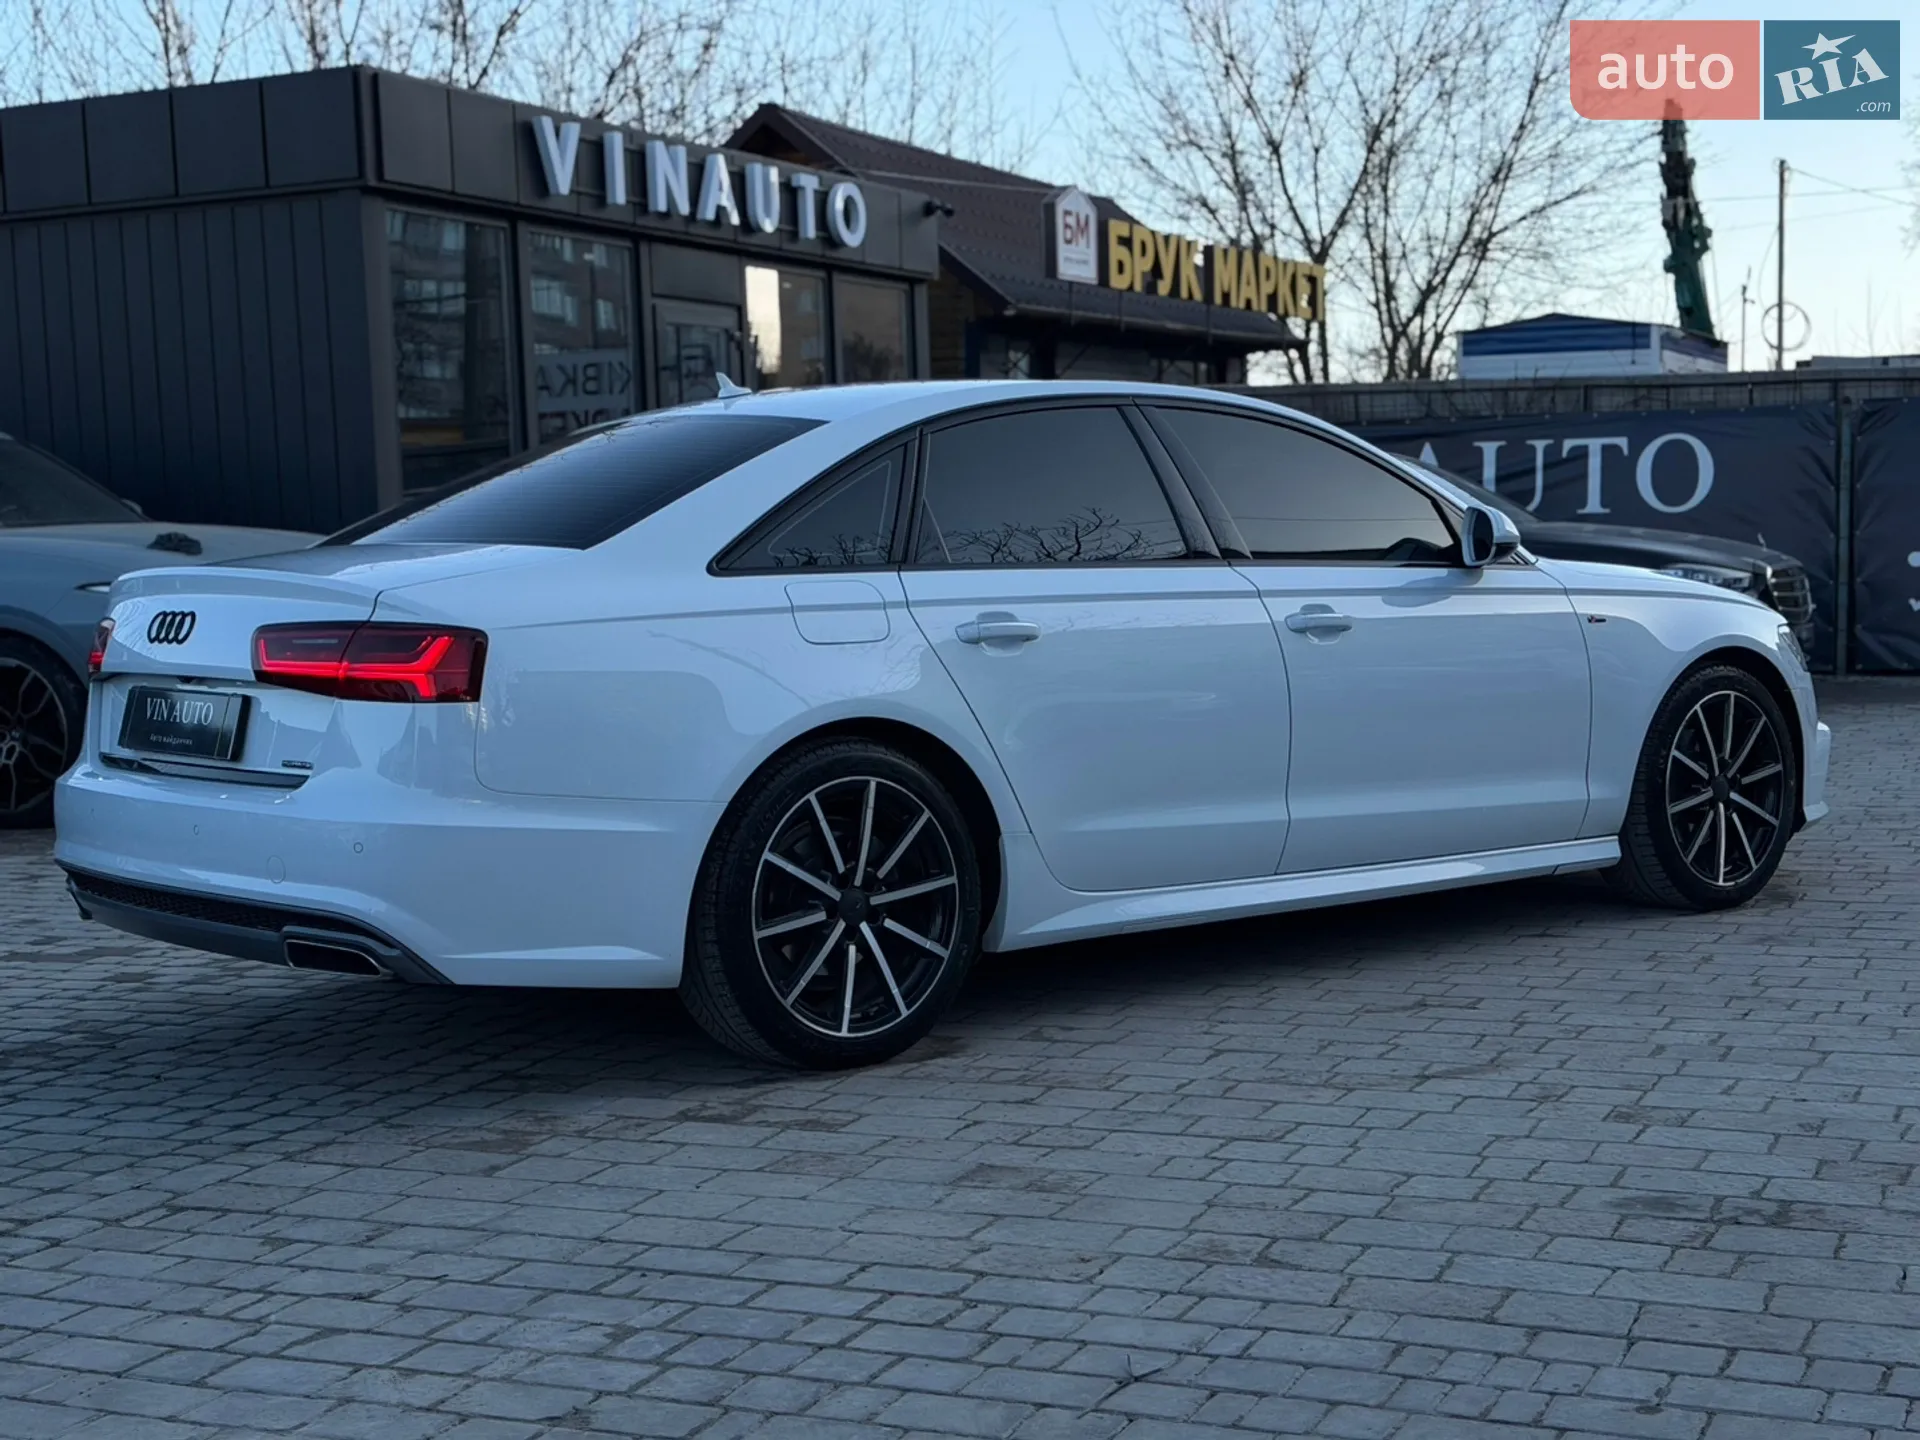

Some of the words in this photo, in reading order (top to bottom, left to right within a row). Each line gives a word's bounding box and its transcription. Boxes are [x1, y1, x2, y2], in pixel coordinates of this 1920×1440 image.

[532, 115, 867, 248] VINAUTO
[1063, 208, 1090, 249] БМ
[1108, 218, 1203, 301] БРУК
[1213, 245, 1327, 322] МАРКЕТ
[1418, 432, 1715, 514] UTO
[146, 697, 171, 721] VIN
[170, 700, 214, 726] AUTO
